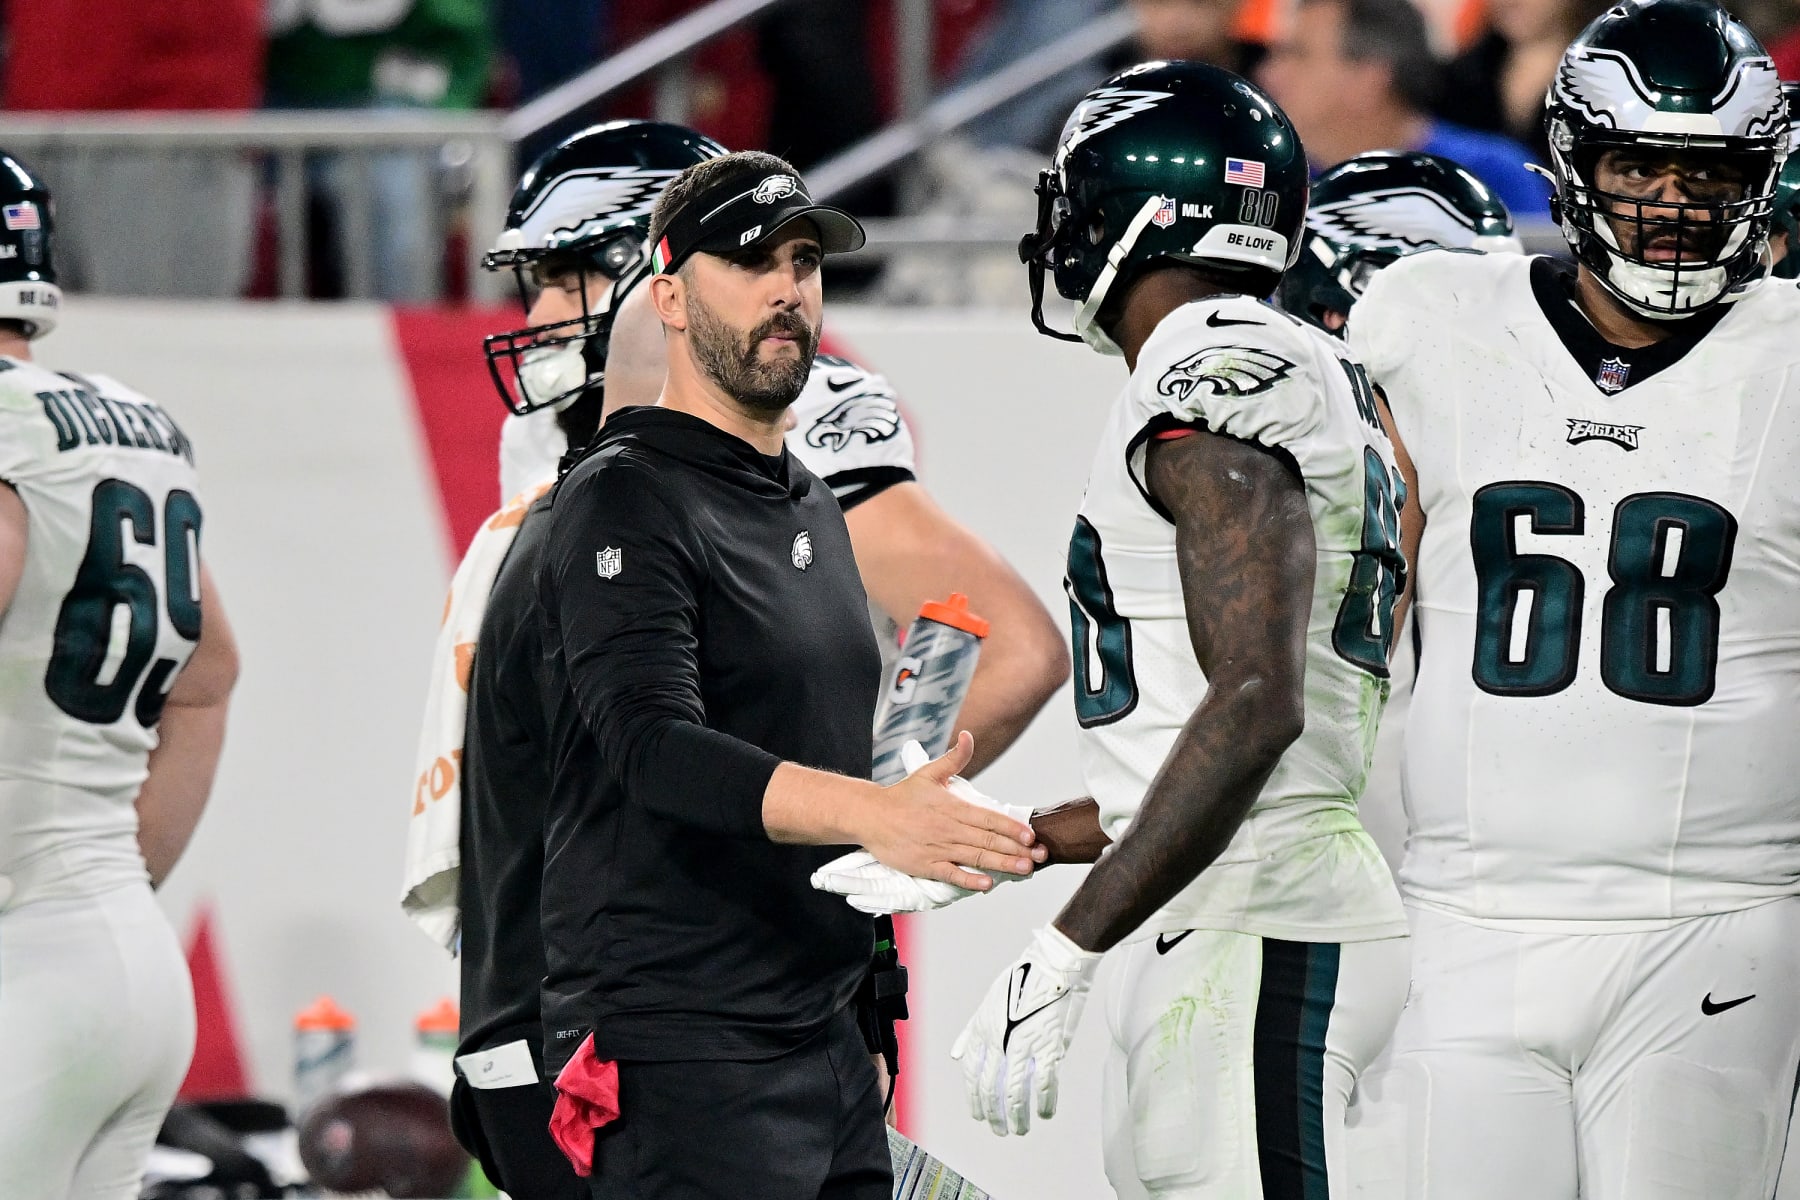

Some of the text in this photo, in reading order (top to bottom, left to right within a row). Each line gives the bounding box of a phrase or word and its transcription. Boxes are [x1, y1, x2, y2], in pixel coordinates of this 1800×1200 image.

[1182, 203, 1214, 219] MLK
[1239, 187, 1279, 229] 80
[1227, 232, 1274, 251] BE LOVE
[0, 244, 18, 259] LK
[1601, 371, 1623, 386] NFL
[1566, 418, 1646, 452] EAGLES
[600, 560, 619, 574] NFL
[1470, 480, 1739, 707] 68
[888, 656, 924, 704] G
